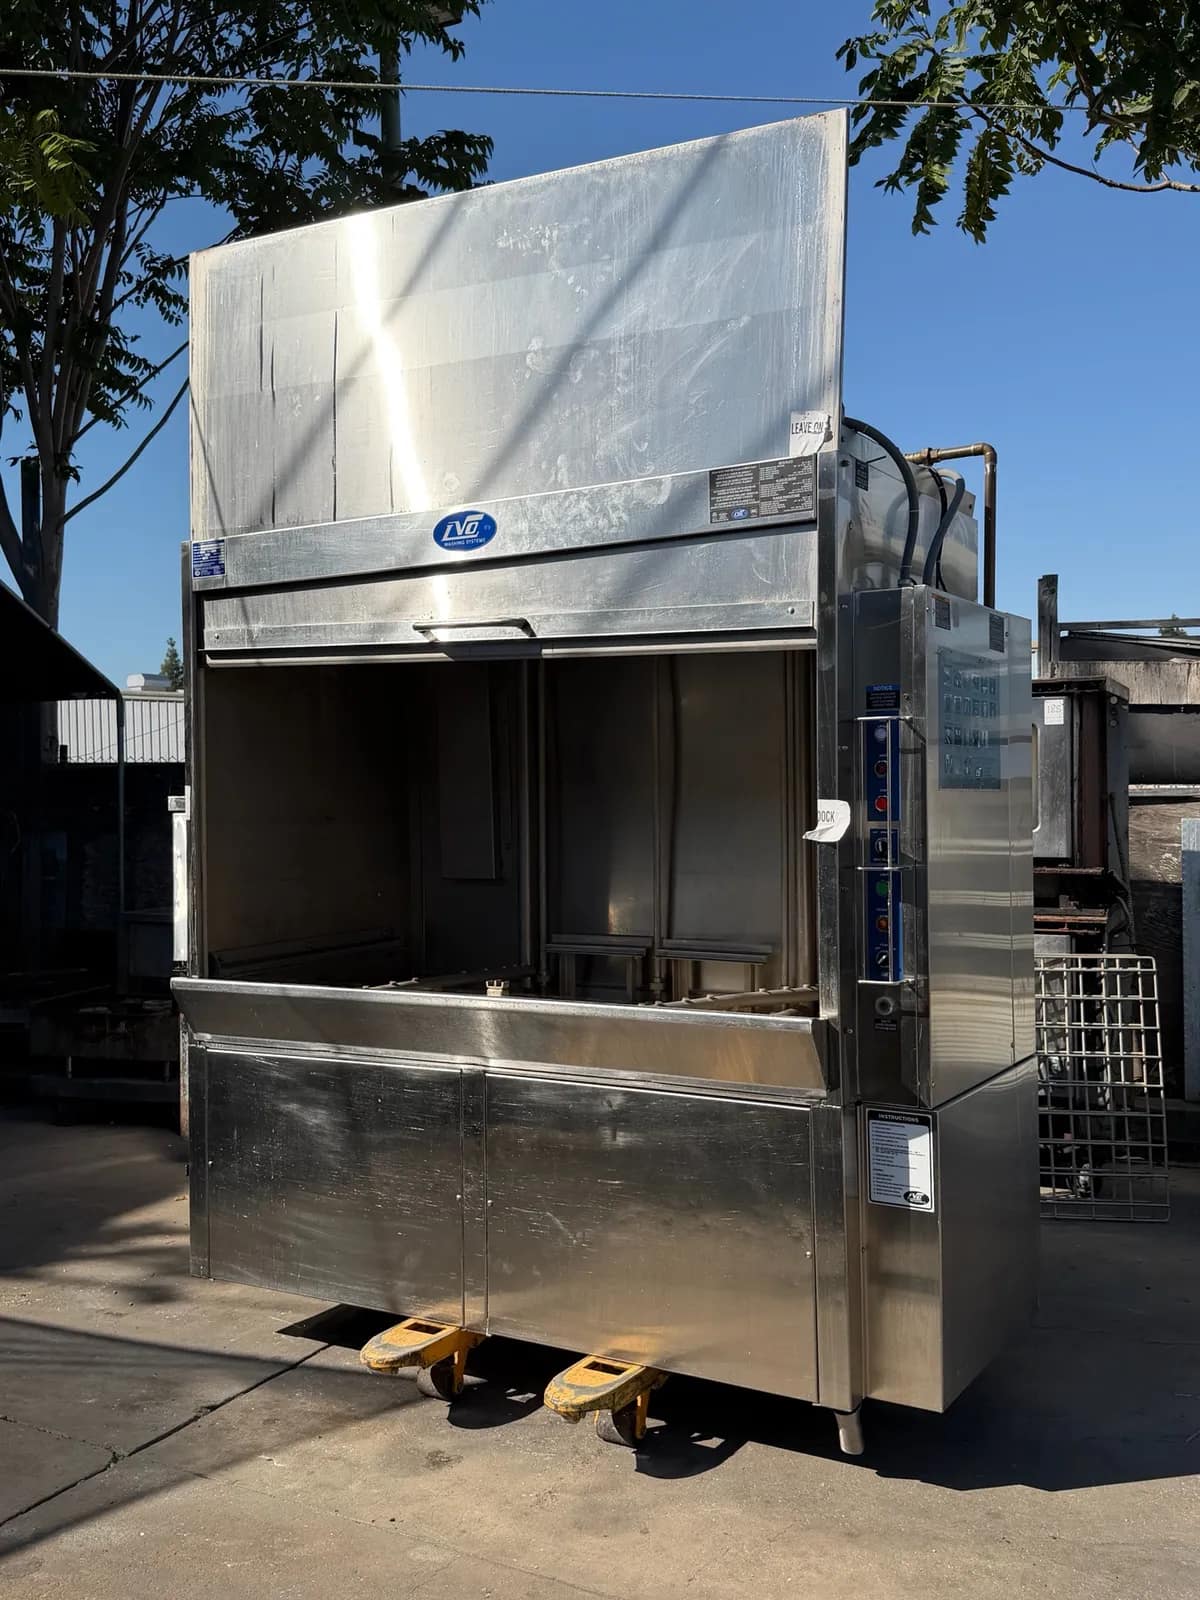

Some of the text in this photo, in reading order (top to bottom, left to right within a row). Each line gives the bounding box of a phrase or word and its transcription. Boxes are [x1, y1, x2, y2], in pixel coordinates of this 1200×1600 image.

[791, 421, 824, 434] LEAVE ON
[878, 1113, 919, 1123] INSTRUCTIONS
